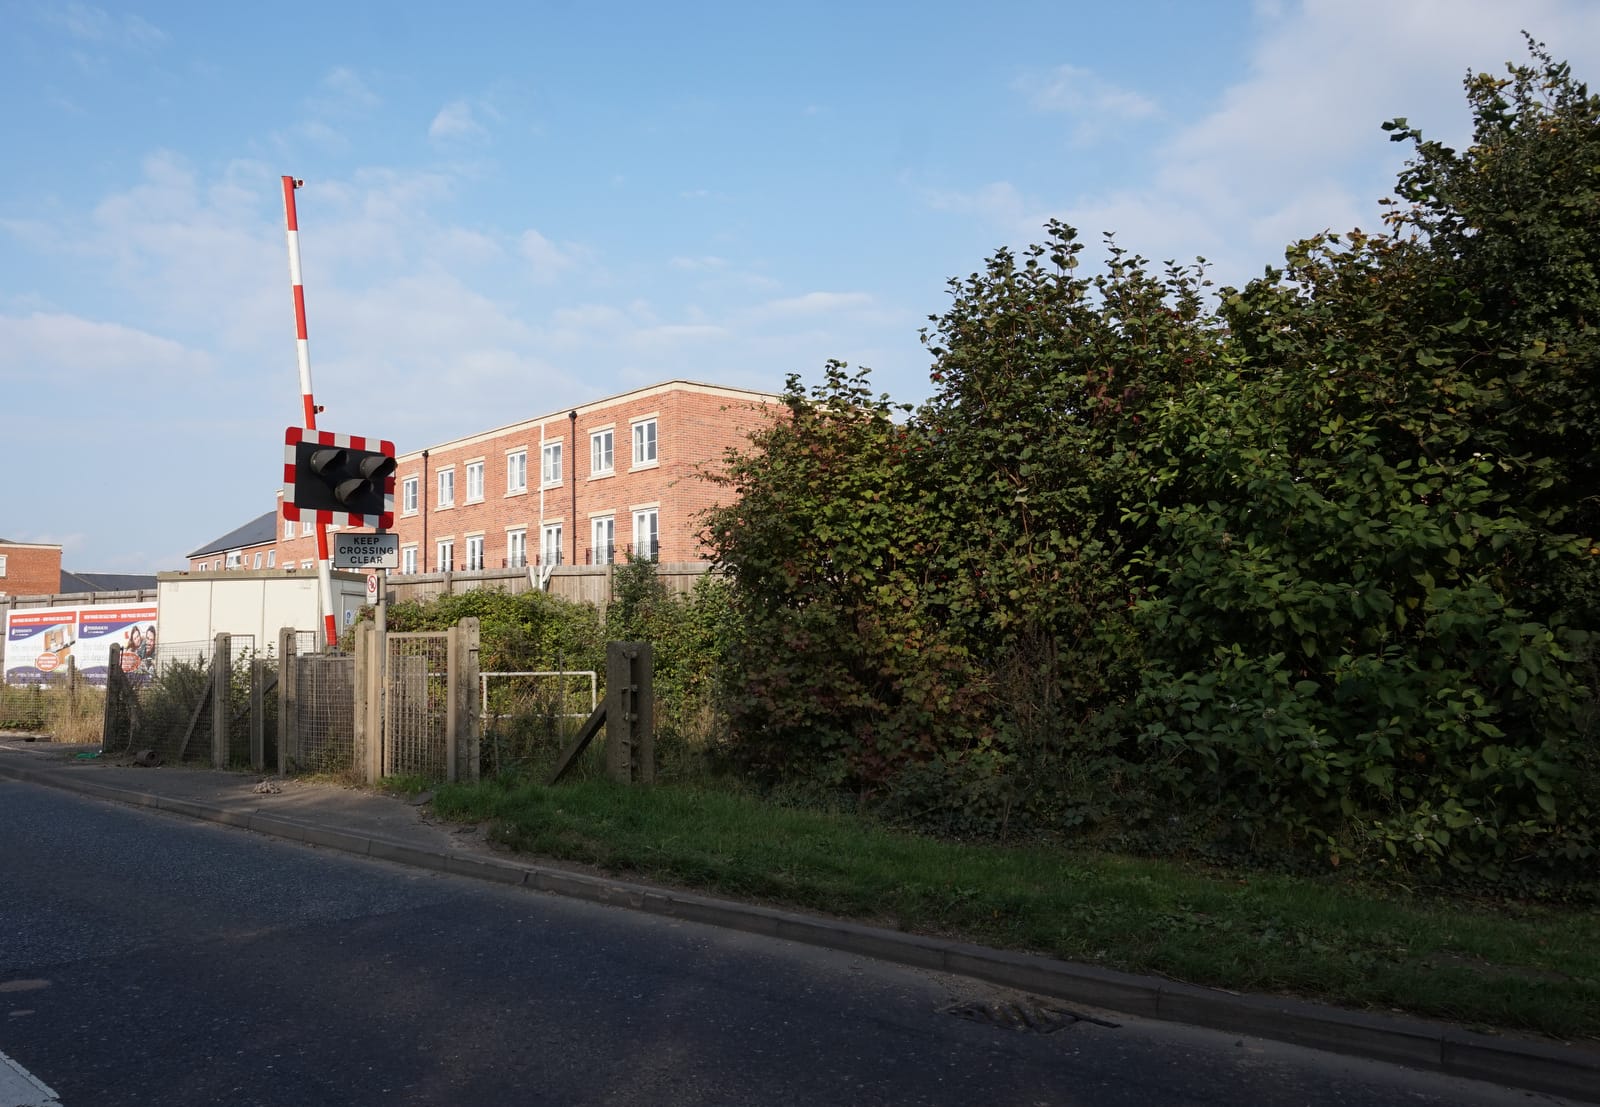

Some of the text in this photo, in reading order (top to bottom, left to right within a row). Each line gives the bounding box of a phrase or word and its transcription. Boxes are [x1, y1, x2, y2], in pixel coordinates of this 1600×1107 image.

[354, 537, 379, 545] KEEP
[339, 546, 394, 555] CROSSING
[350, 556, 383, 564] CLEAR
